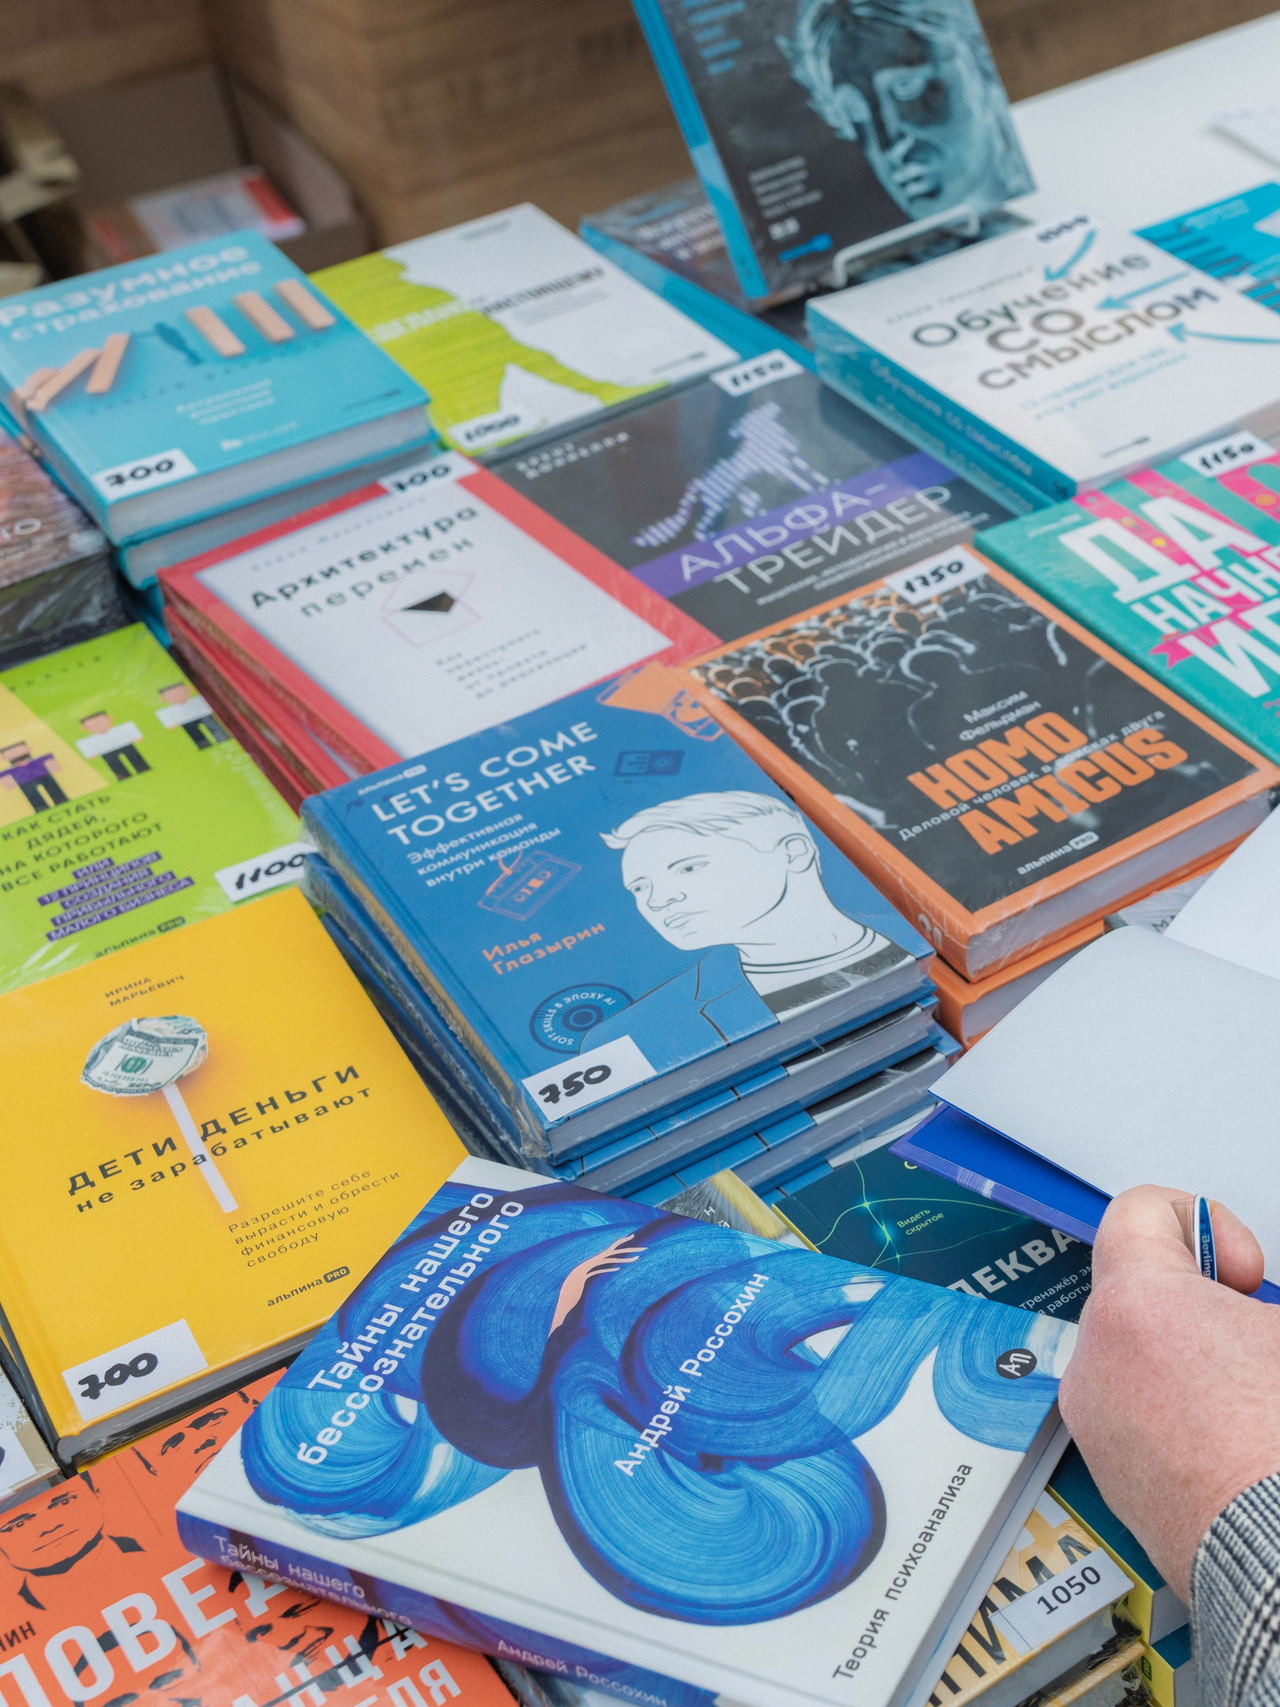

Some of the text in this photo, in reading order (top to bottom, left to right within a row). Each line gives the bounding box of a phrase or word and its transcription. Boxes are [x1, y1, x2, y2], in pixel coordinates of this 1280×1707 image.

[912, 253, 1151, 347] Обучение
[104, 459, 175, 488] 700
[1198, 442, 1255, 470] 1150
[251, 506, 479, 608] Архитектура
[680, 483, 887, 582] АЛЬФА-
[711, 485, 952, 594] ТРЕЙДЕР
[1058, 496, 1272, 603] ДА
[300, 538, 476, 619] перемен
[959, 700, 1042, 742] Фельдман
[963, 690, 1029, 724] Максим
[480, 721, 598, 777] COME
[906, 712, 1089, 810] HOMO
[387, 755, 597, 845] TOGETHER
[899, 802, 971, 842] Деловой
[973, 771, 1039, 806] человек
[1054, 732, 1119, 768] поисках
[1121, 709, 1166, 738] друга
[957, 727, 1189, 856] AMICUS
[0, 812, 149, 878] НА КОТОРОГО
[2, 796, 111, 842] КАК СТАТЬ
[26, 815, 107, 850] ДЯДЕЙ,
[407, 814, 523, 865] Эффективная
[1, 822, 164, 893] ВСЕ РАБОТАЮТ
[59, 853, 159, 897] ПРИНЦИПОВ
[77, 859, 112, 878] ИЛИ
[234, 852, 307, 890] 1100
[417, 822, 538, 876] коммуникация
[425, 827, 562, 888] внутри команды
[1017, 833, 1098, 876] альпина PRO
[50, 877, 193, 939] МАЛОГО БИЗНЕСА
[54, 872, 173, 926] ПРИБЫЛЬНОГО
[63, 869, 151, 907] СОЗДАНИЯ
[482, 933, 542, 962] Илья
[492, 923, 606, 975] Глазырин
[105, 976, 152, 998] ИРИНА
[109, 974, 185, 1007] МАРЬЕВИЧ
[563, 991, 604, 1005] ЭПОХУ
[604, 995, 617, 1007] AI
[543, 1008, 558, 1032] SKILLS
[546, 1030, 575, 1047] SOFT
[538, 1064, 612, 1104] 750
[68, 1064, 360, 1196] ДЕТИ ДЕНЬГИ
[75, 1086, 374, 1213] не зарабатывают
[227, 1168, 373, 1234] Разрешите себе
[233, 1209, 308, 1246] вырасти
[327, 1171, 402, 1208] обрести
[897, 1207, 931, 1229] Видеть
[904, 1211, 945, 1237] скрытое
[240, 1205, 351, 1257] финансовую
[246, 1231, 321, 1268] свободу
[266, 1266, 350, 1308] альпина PRO
[307, 1191, 495, 1389] Тайны нашего
[1019, 1272, 1079, 1312] тренажёр
[297, 1200, 524, 1466] бессознательного
[77, 1352, 159, 1400] 700
[613, 1271, 770, 1477] Андрей Россохин
[213, 1534, 366, 1600] Тайны нашего
[832, 1462, 974, 1682] Теория психоанализа
[1036, 1565, 1102, 1616] 1050
[497, 1638, 668, 1707] Андрей Россохин
